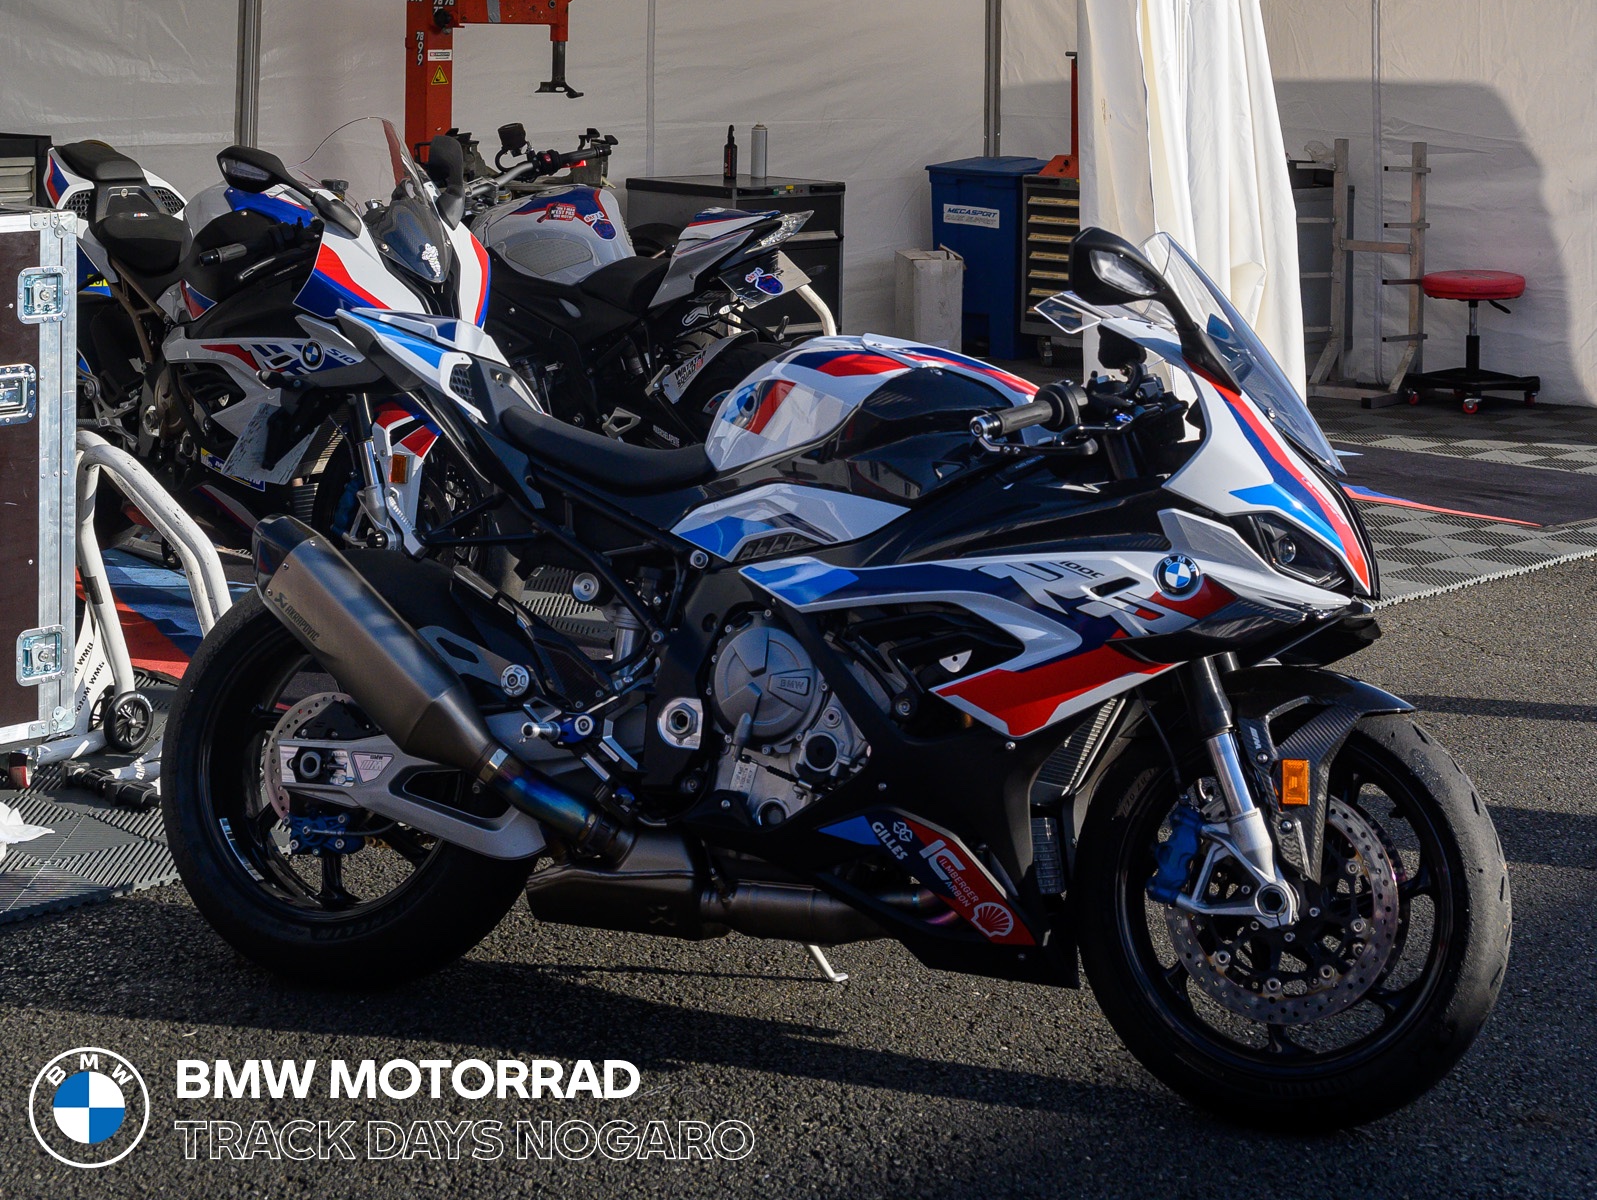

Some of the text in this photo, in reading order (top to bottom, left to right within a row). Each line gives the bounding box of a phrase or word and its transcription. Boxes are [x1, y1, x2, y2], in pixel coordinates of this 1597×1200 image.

[1164, 555, 1199, 574] BMW
[780, 678, 805, 690] BMW
[134, 756, 146, 780] BMW
[872, 821, 908, 860] GILLES
[938, 858, 979, 903] ILMBERGER
